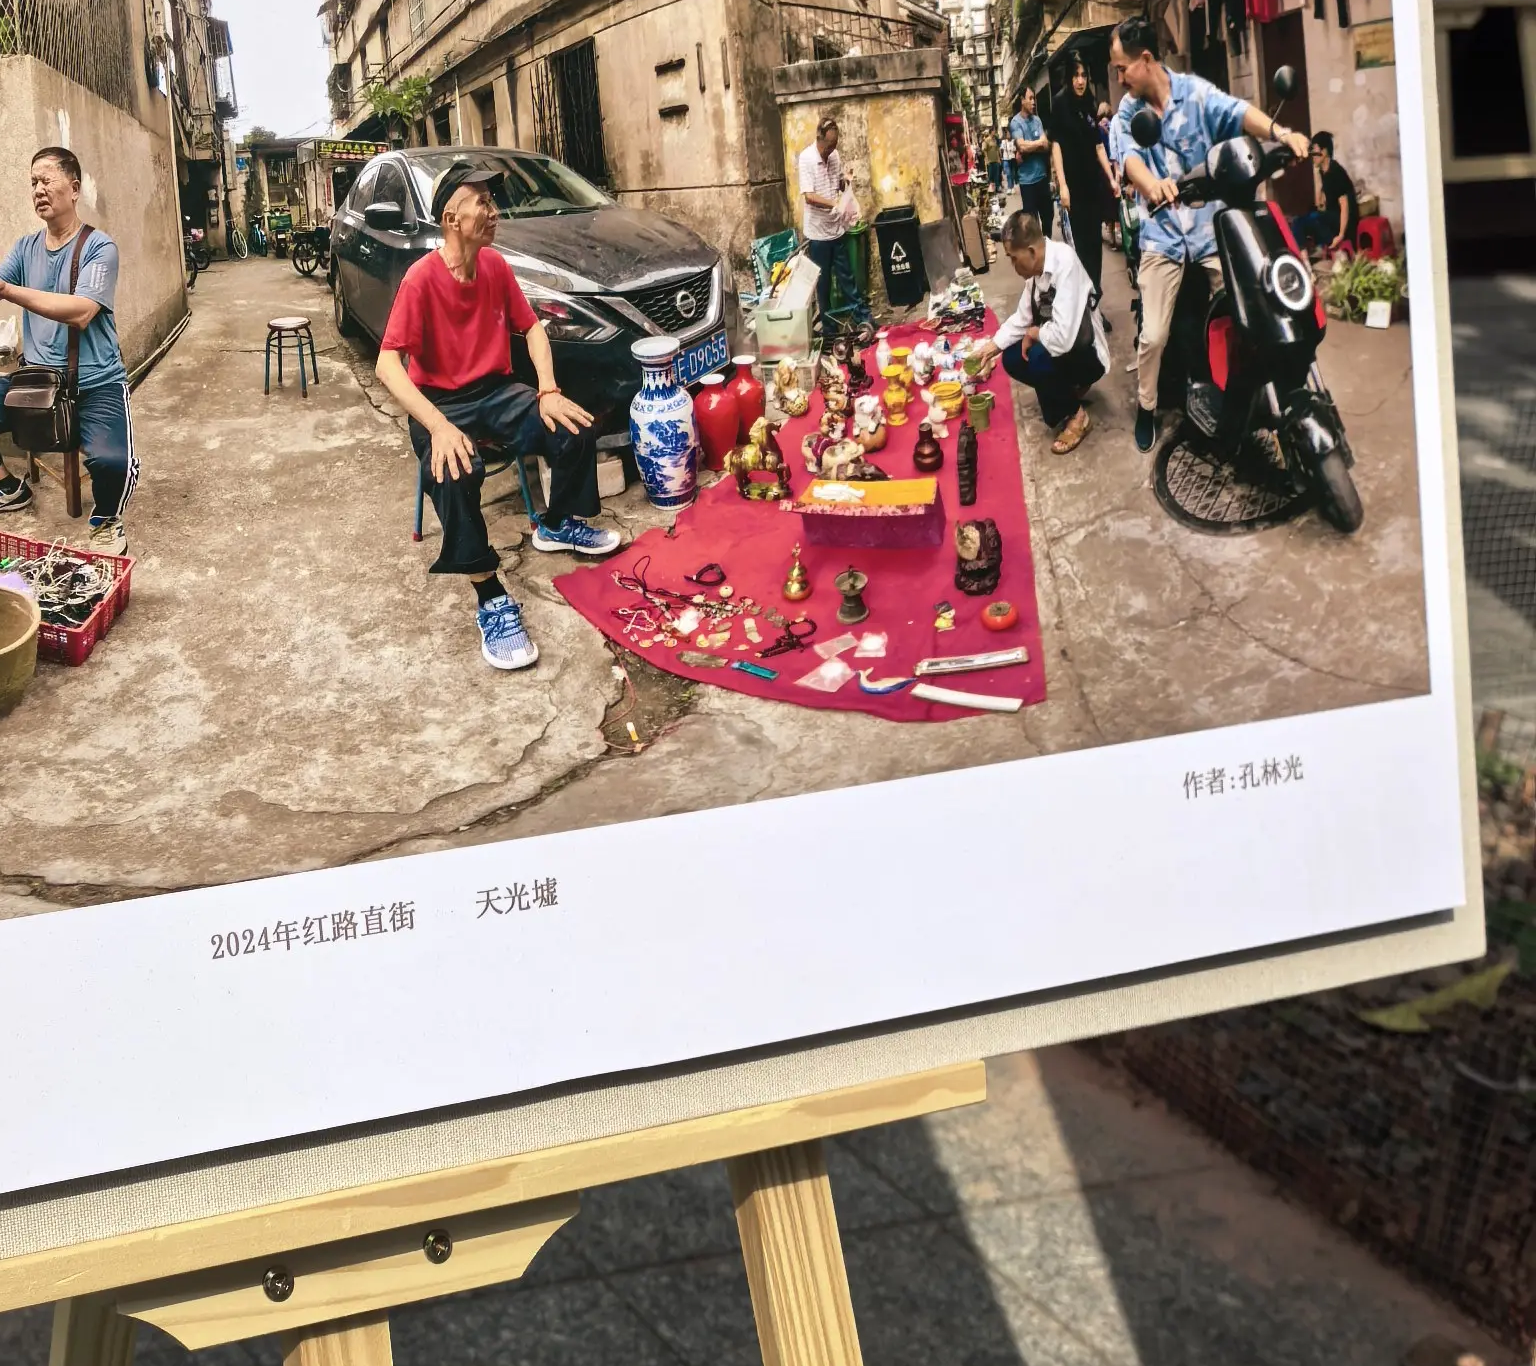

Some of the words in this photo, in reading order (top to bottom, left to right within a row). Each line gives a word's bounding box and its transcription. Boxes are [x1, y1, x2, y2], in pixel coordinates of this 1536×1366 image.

[1182, 754, 1304, 800] 作者:孔林光
[210, 900, 415, 961] 2024年红路直街
[475, 877, 559, 920] 天光墟
